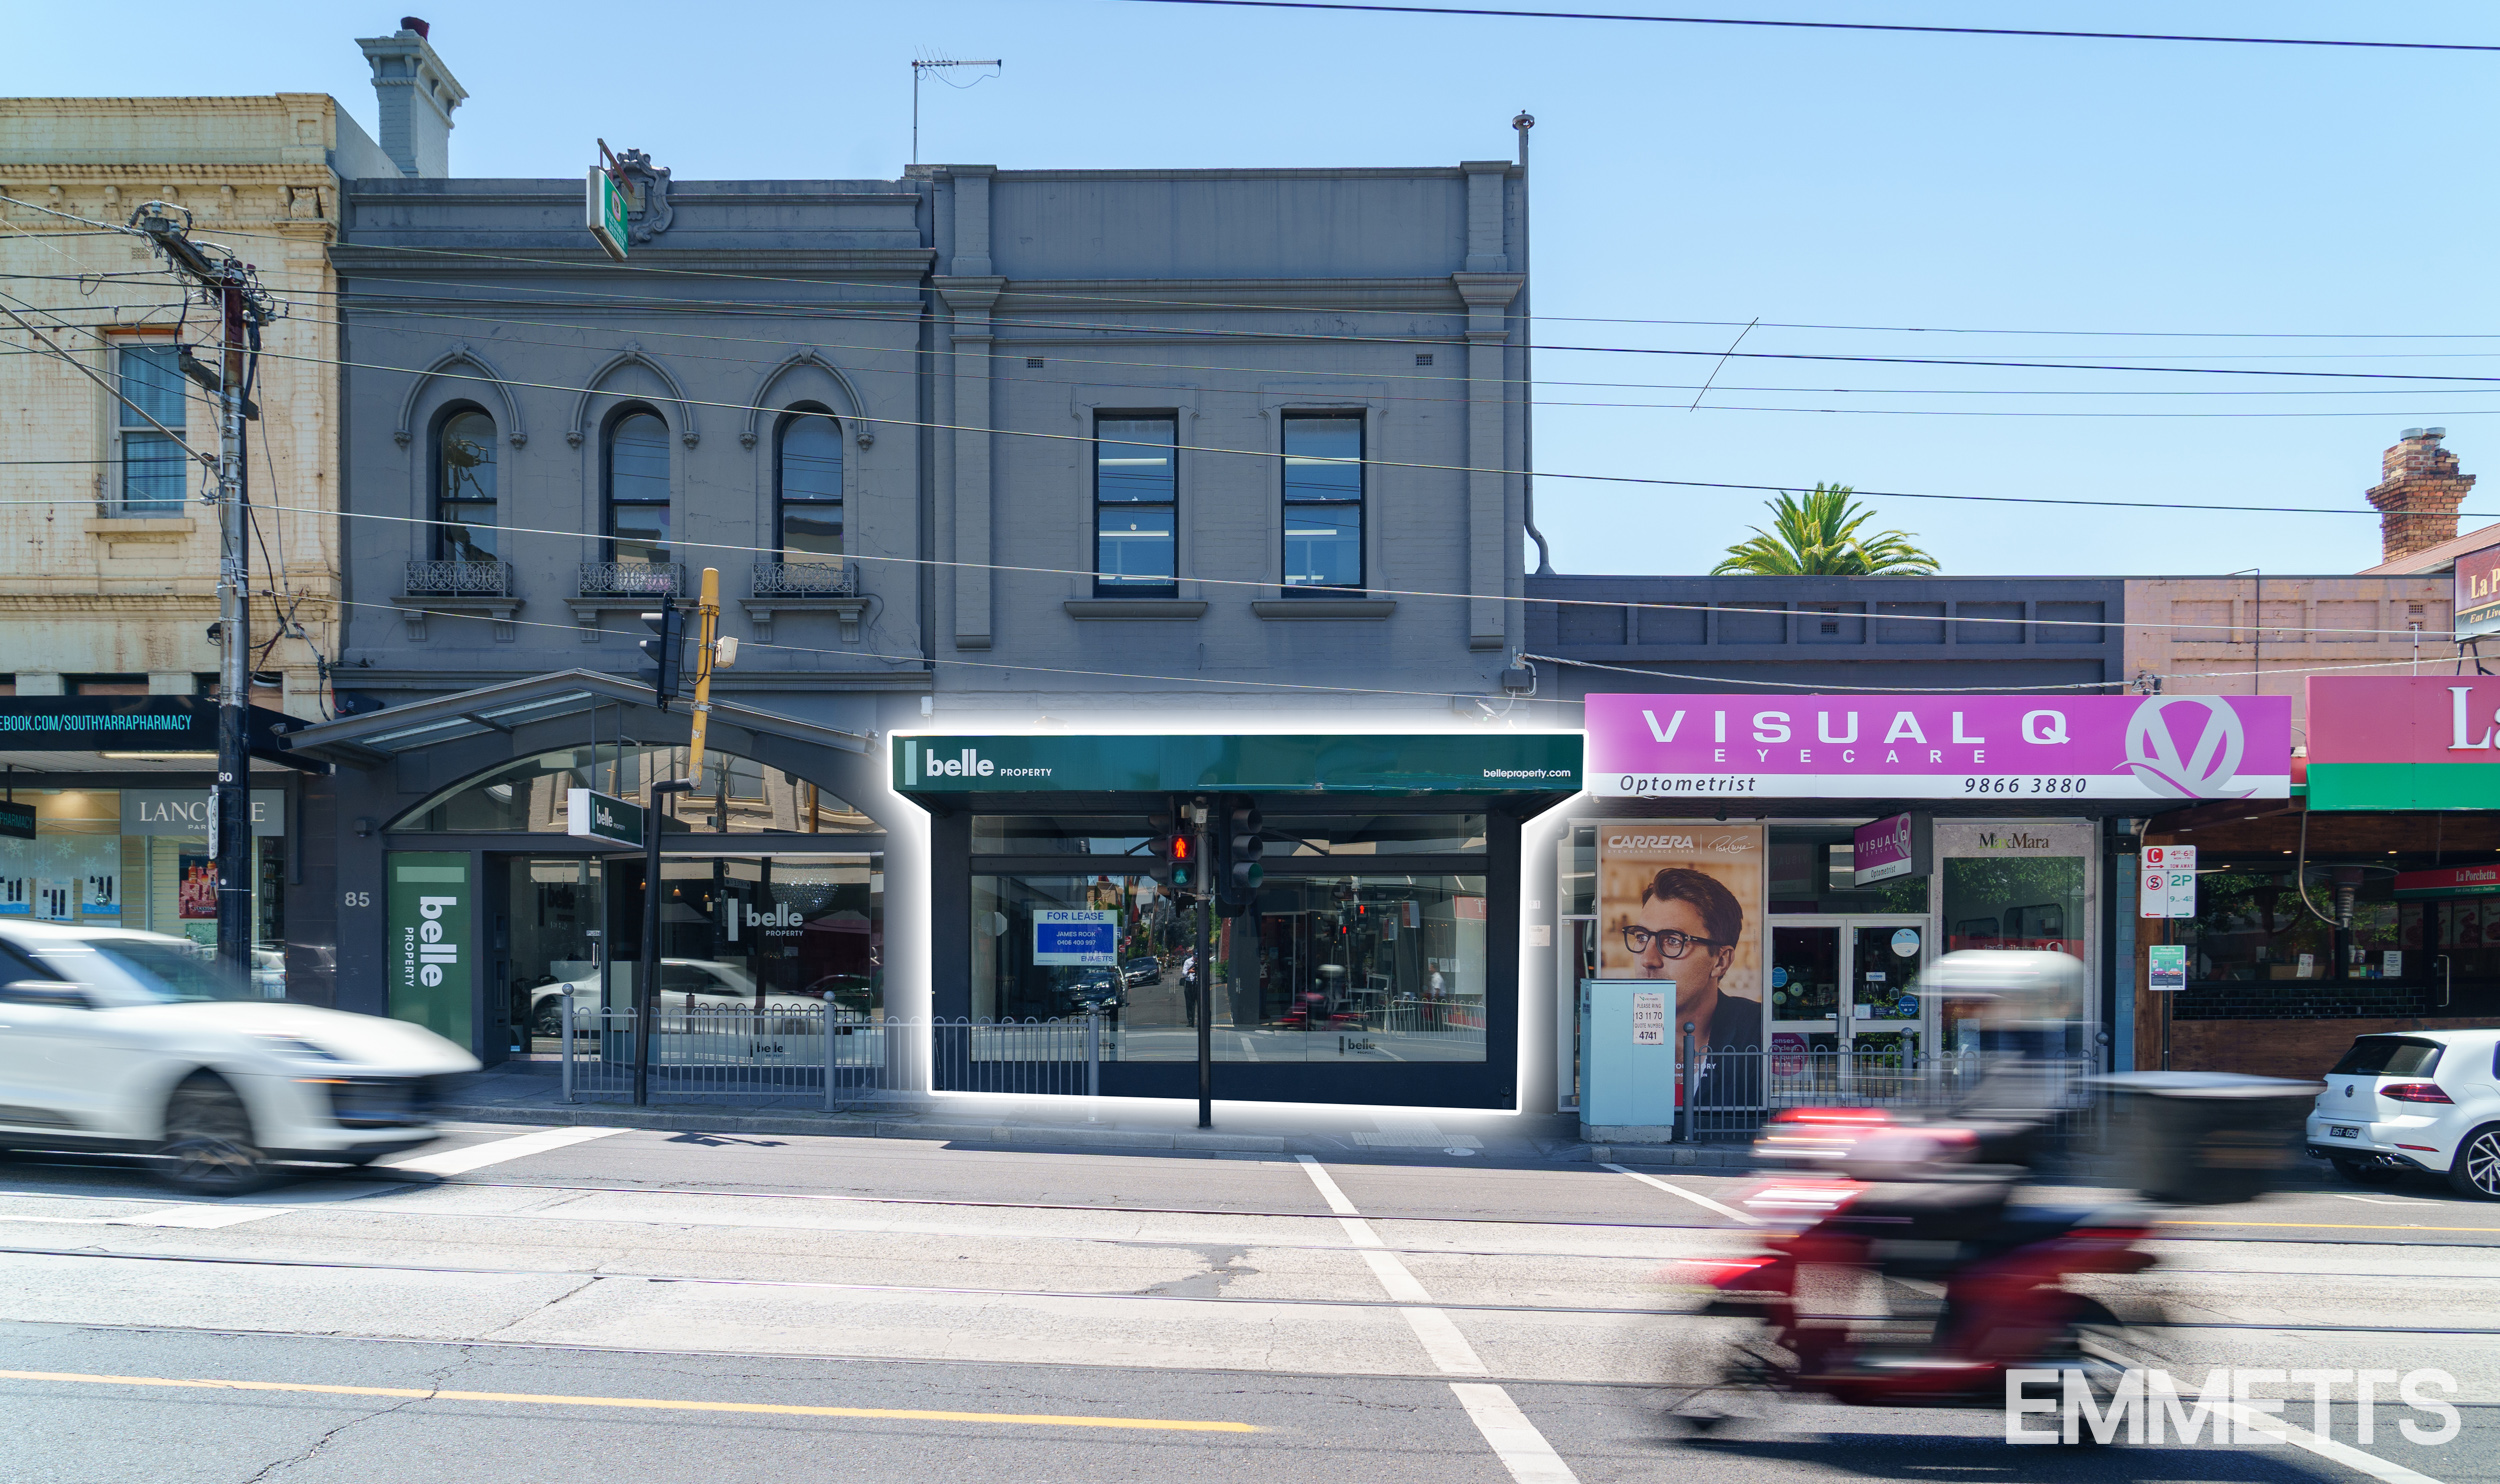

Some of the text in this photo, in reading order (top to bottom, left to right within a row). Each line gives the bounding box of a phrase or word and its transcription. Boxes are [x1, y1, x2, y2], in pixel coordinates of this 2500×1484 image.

[2470, 574, 2488, 599] La
[2470, 613, 2484, 624] Eat
[2447, 687, 2500, 750] L
[1641, 709, 2071, 745] VISUAL Q
[926, 748, 1052, 777] belle PROPERTY
[1713, 748, 1986, 764] EYECARE
[218, 772, 233, 782] 60
[1483, 768, 1571, 779] belleproperty.com
[1619, 774, 1756, 795] Optometrist
[1964, 777, 2087, 793] 9866 3880
[140, 801, 265, 822] LANCE
[596, 804, 613, 827] belle
[1608, 835, 1694, 849] CARRERA
[1858, 829, 1907, 853] VISUAL Q
[1979, 832, 2050, 849] MaxMara
[1870, 865, 1896, 879] Optometrist
[2171, 874, 2192, 886] 2P
[2456, 869, 2496, 882] La Porchetta
[345, 891, 370, 907] 85
[746, 903, 804, 927] belle
[1047, 912, 1104, 920] FOR LEASE
[420, 896, 457, 987] belle
[404, 927, 415, 987] PROPERTY
[1635, 1011, 1663, 1020] 13 11 70
[1639, 1031, 1657, 1040] 4741
[1348, 1038, 1376, 1050] belle
